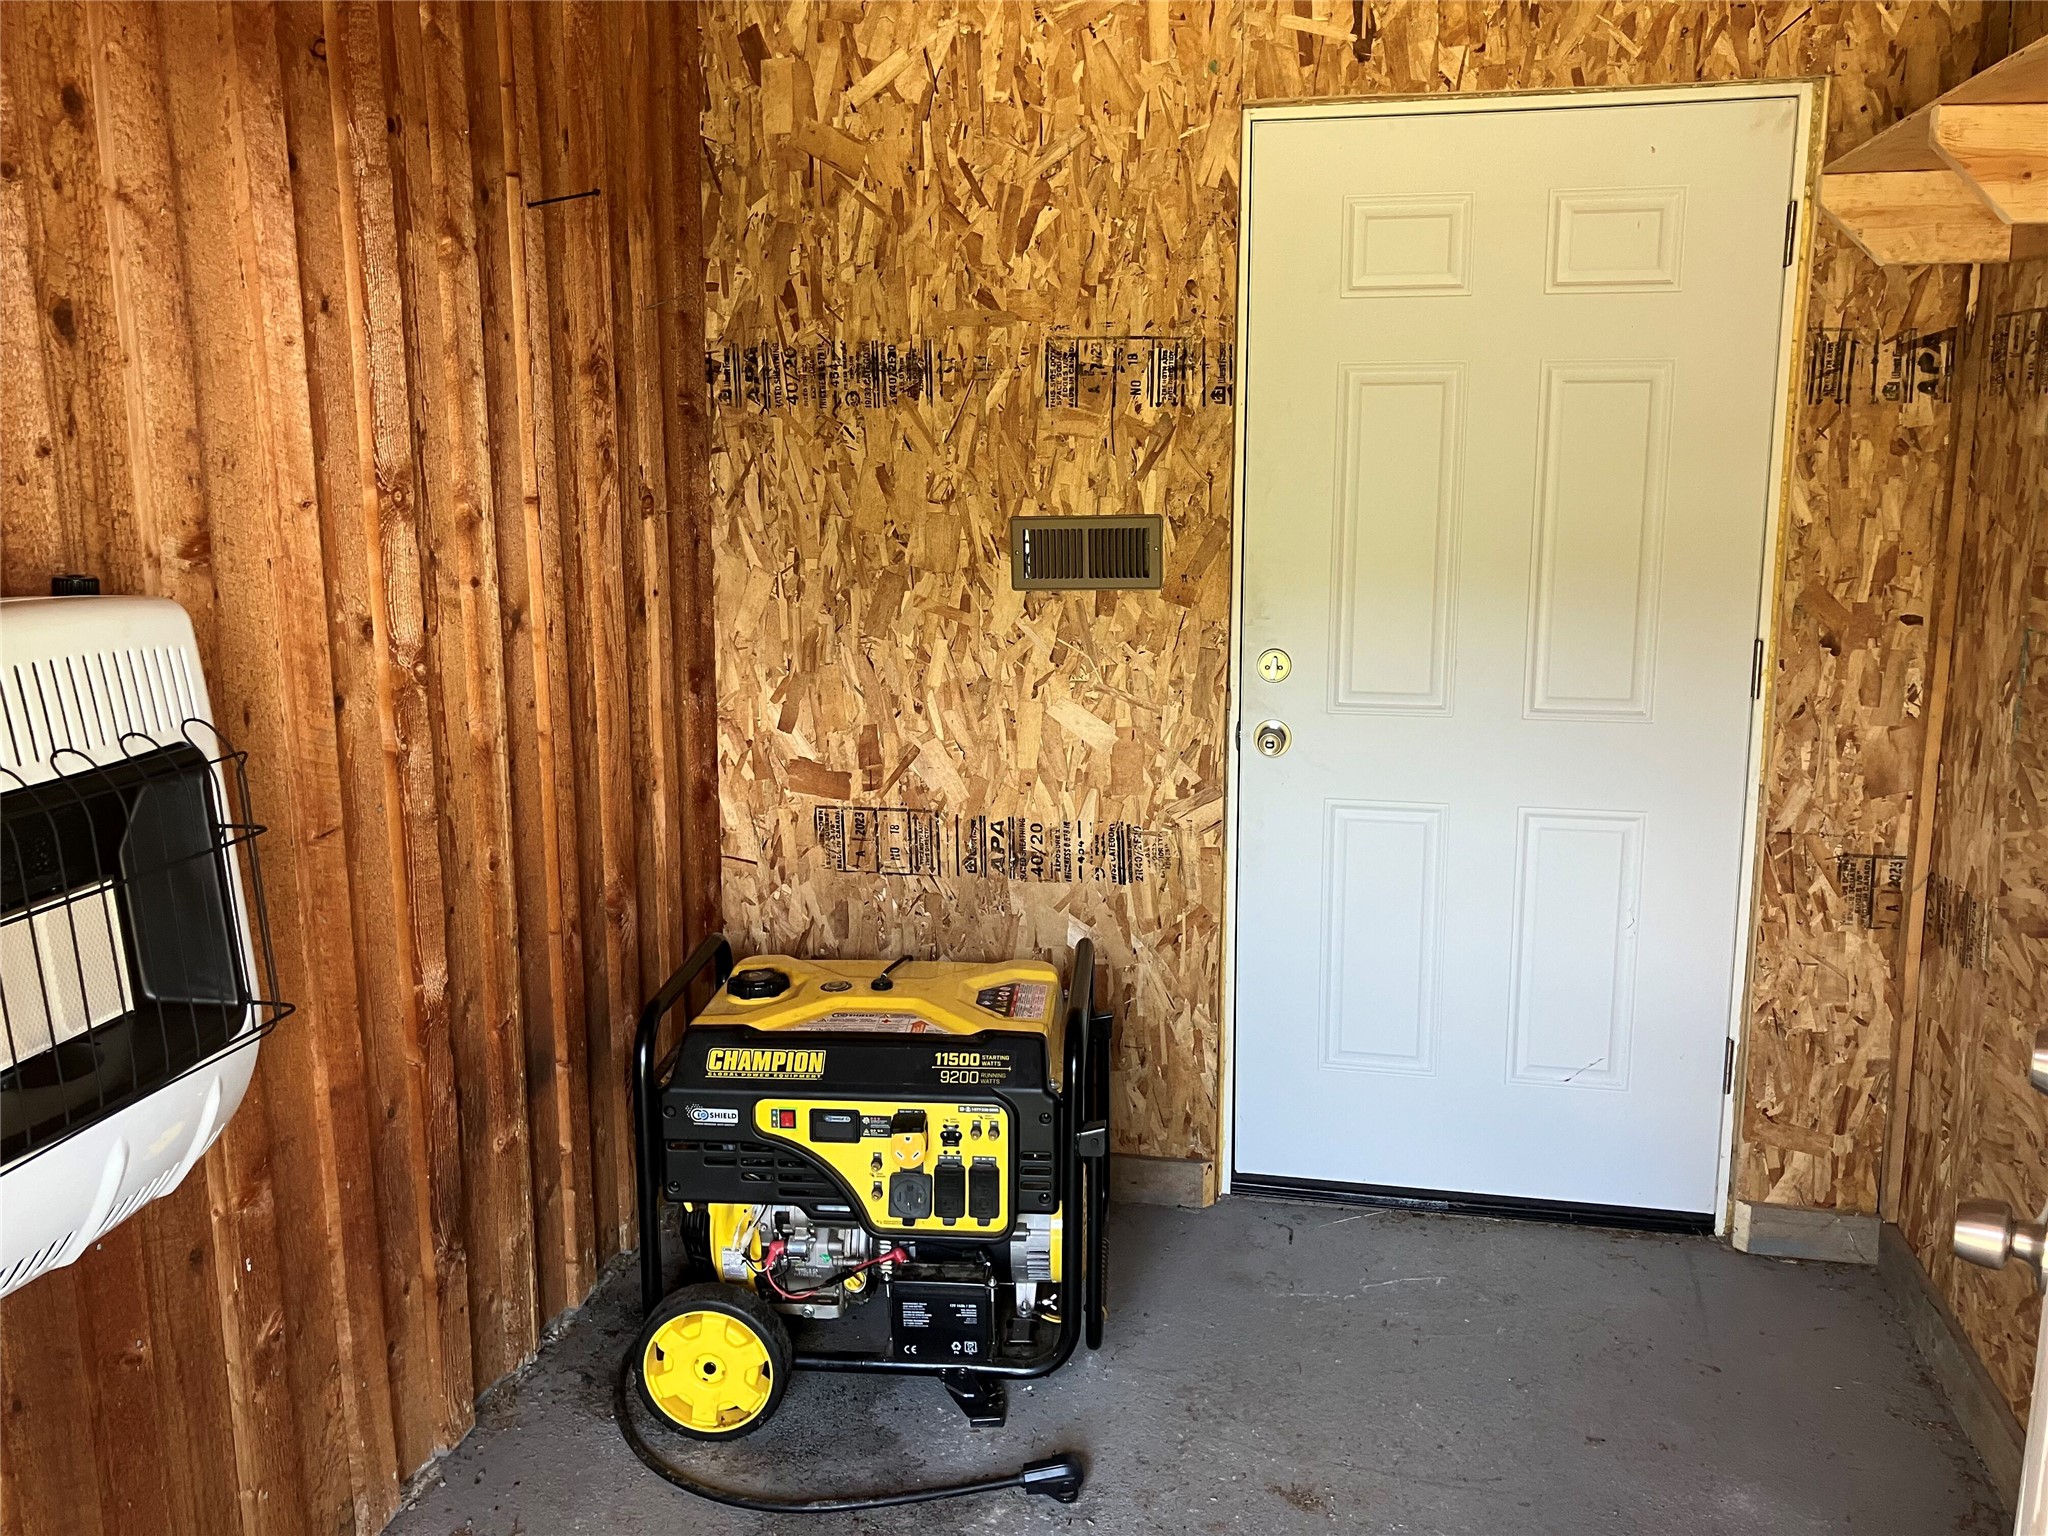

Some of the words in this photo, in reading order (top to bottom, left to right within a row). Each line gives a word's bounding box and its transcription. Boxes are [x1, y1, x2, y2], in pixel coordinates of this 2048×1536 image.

[1127, 353, 1138, 365] 18
[784, 348, 801, 406] 40/20
[1130, 380, 1141, 396] NO
[854, 812, 865, 835] 2023
[890, 825, 900, 834] 18
[990, 820, 1005, 875] APA
[1018, 817, 1027, 856] SHEATHING
[890, 847, 901, 860] NO
[1030, 823, 1048, 878] 40/20
[1019, 858, 1027, 879] RATED
[1863, 859, 1871, 891] CANADA
[1887, 861, 1902, 888] 2023
[1885, 904, 1899, 912] A
[708, 1049, 824, 1073] CHAMPION
[935, 1052, 980, 1066] 11500
[940, 1070, 979, 1084] 9200
